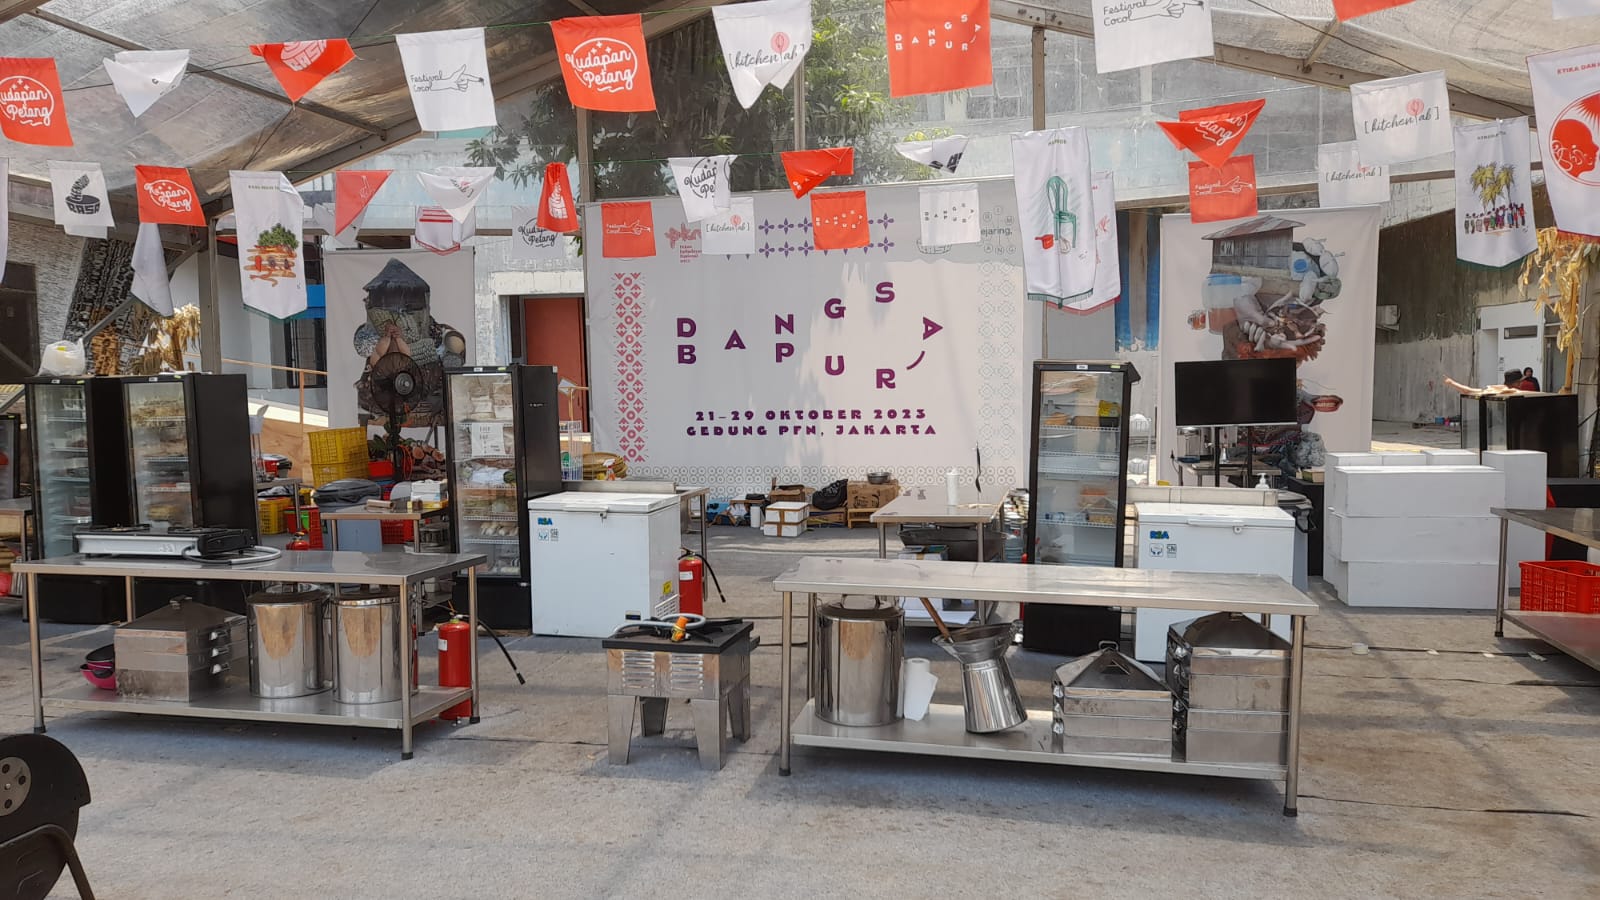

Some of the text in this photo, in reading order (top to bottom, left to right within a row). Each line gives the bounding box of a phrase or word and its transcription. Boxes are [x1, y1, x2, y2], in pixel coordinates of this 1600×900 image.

[565, 49, 632, 72] Kudapan
[410, 69, 444, 84] Festival
[582, 68, 634, 91] Petang
[0, 88, 48, 107] udapan
[7, 103, 51, 127] Petang
[1199, 120, 1235, 147] etang
[980, 226, 1013, 238] ejaring,
[527, 234, 556, 248] Petang
[765, 409, 863, 421] OKTOBER
[873, 408, 927, 420] 2023
[686, 424, 938, 437] GEDUNG PFN, JAKARTA
[1149, 531, 1170, 540] RSA
